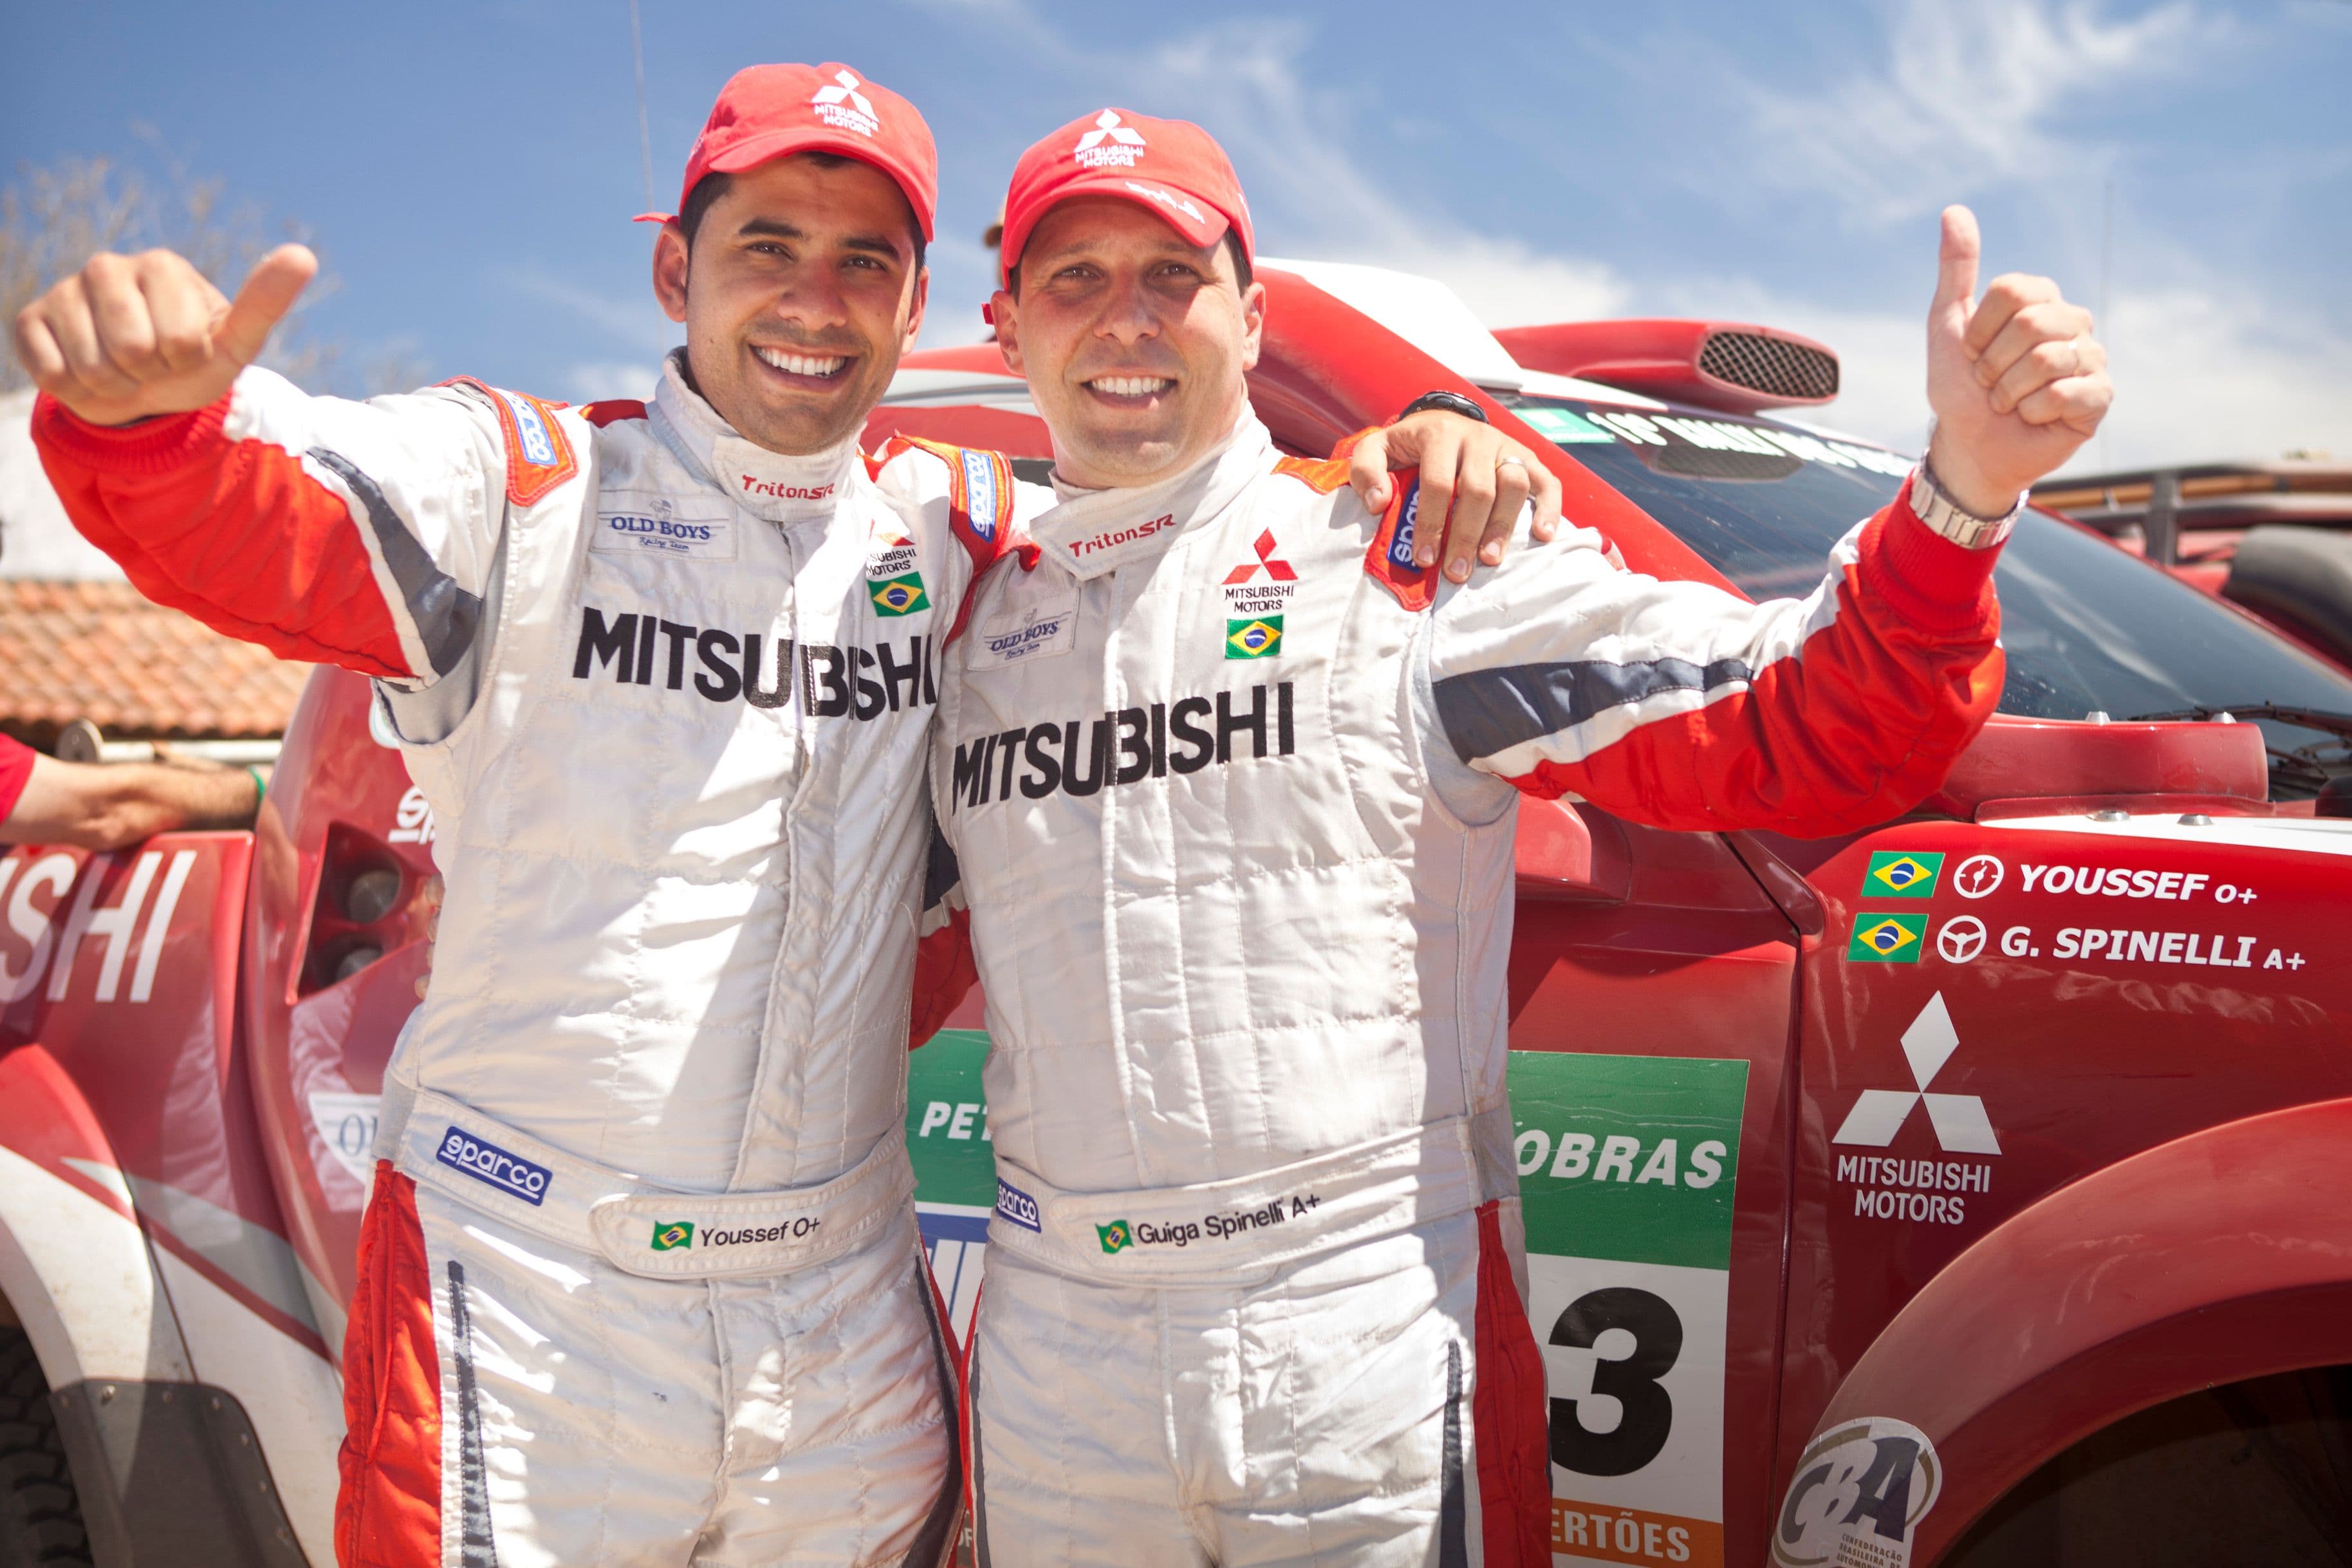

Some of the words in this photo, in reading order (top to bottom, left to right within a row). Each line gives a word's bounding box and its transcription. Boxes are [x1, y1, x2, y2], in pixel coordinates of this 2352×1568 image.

[814, 103, 879, 132] MITSUBISHI
[824, 114, 872, 138] MOTORS
[1075, 145, 1144, 163] MITSUBISHI
[1083, 154, 1135, 168] MOTORS
[611, 517, 655, 533] OLD
[659, 521, 710, 540] BOYS
[1069, 513, 1177, 558] TritonSR
[1225, 586, 1294, 600] MITSUBISHI
[1234, 599, 1283, 613] MOTORS
[991, 633, 1021, 651] OLD
[1024, 621, 1059, 642] BOYS
[573, 606, 937, 721] MITSUBISHI
[952, 681, 1295, 816] MITSUBISHI
[2021, 864, 2209, 901] YOUSSEF
[0, 849, 198, 1003] SHI
[2001, 926, 2039, 957] G.
[2053, 927, 2257, 968] SPINELLI
[2263, 948, 2306, 971] A+
[445, 1134, 544, 1192] sparco
[1837, 1155, 1990, 1193] MITSUBISHI
[997, 1183, 1037, 1221] sparco
[1855, 1190, 1965, 1225] MOTORS
[701, 1221, 790, 1247] Youssef
[793, 1217, 820, 1238] O+
[1138, 1222, 1200, 1247] Guiga
[1205, 1198, 1286, 1240] Spinelli
[1292, 1194, 1320, 1218] A+
[1548, 1287, 1683, 1477] 3
[1839, 1542, 1884, 1567] BRASILEIRA
[1842, 1533, 1903, 1562] CONFEDERAÇÃO
